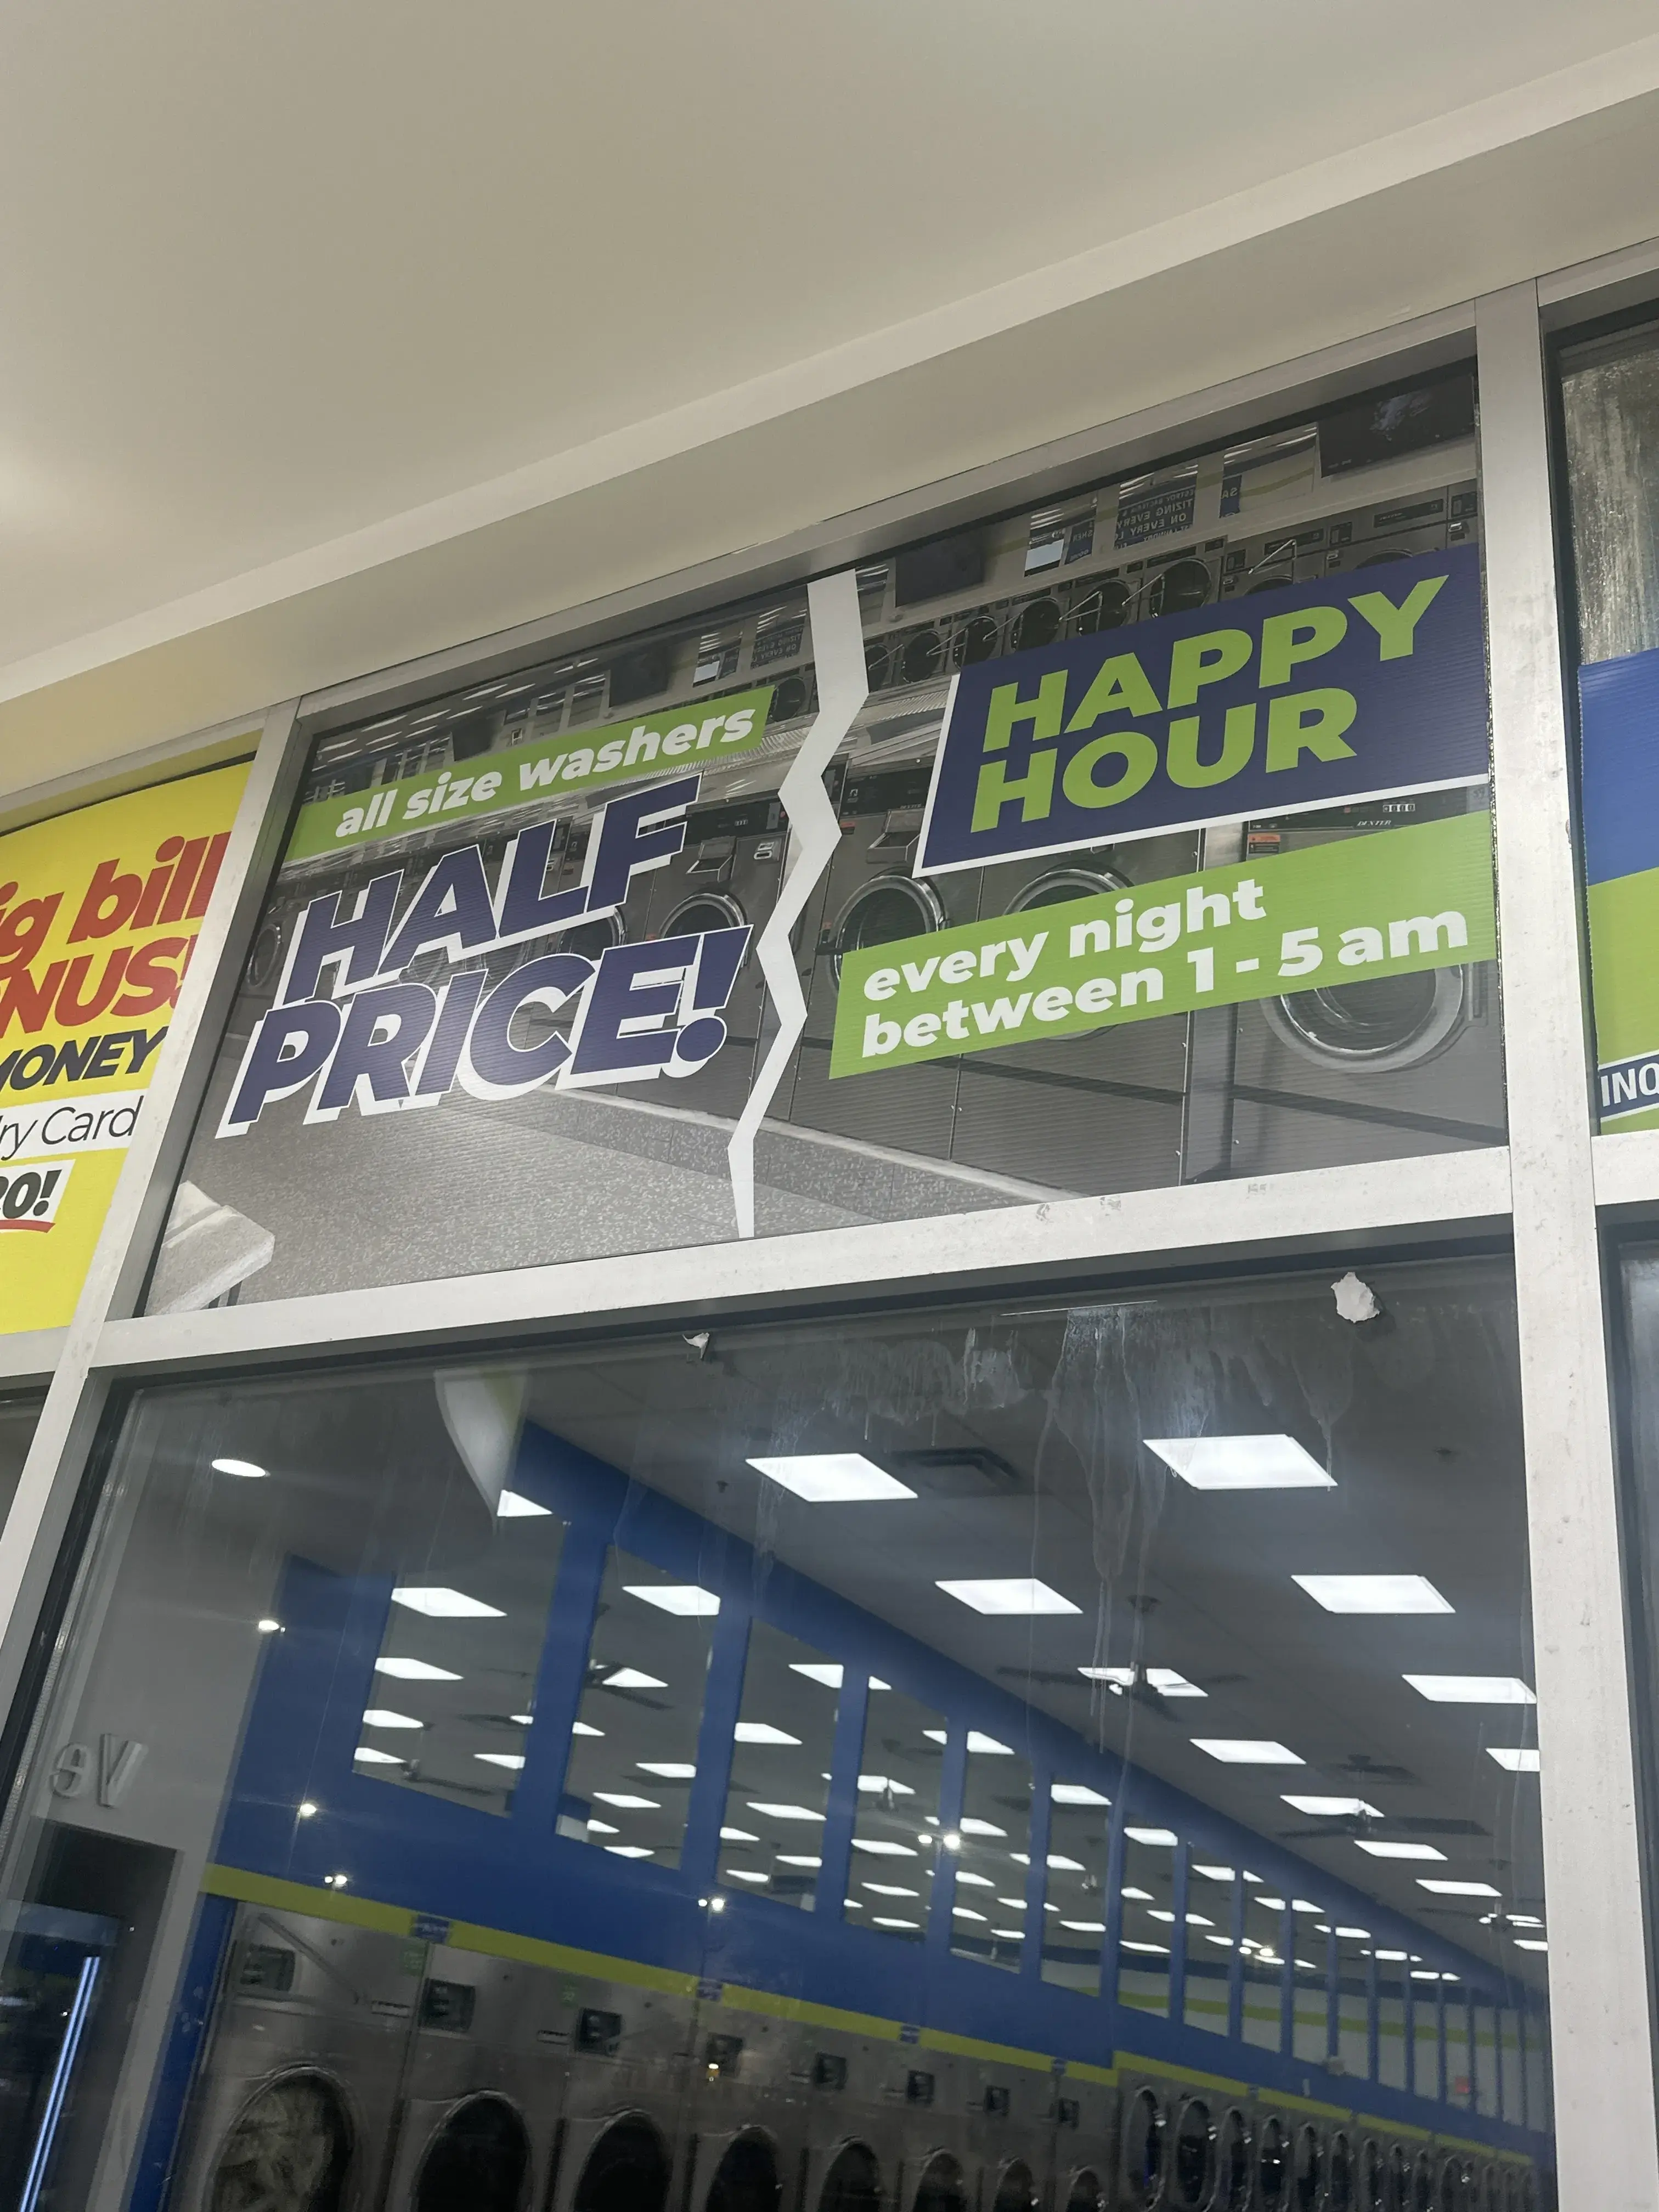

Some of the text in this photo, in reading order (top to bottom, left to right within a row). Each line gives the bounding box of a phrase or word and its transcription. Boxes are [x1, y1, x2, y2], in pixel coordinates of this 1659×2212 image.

[983, 574, 1449, 752] HAPPY
[335, 708, 756, 838] all size washers
[970, 687, 1357, 833] HOUR
[66, 832, 232, 944] bill
[281, 773, 702, 1007] HALF
[863, 878, 1267, 1002] every night
[216, 924, 754, 1138] PRICE!
[862, 910, 1468, 1059] between 1 - 5 am
[0, 1095, 145, 1161] ry Card
